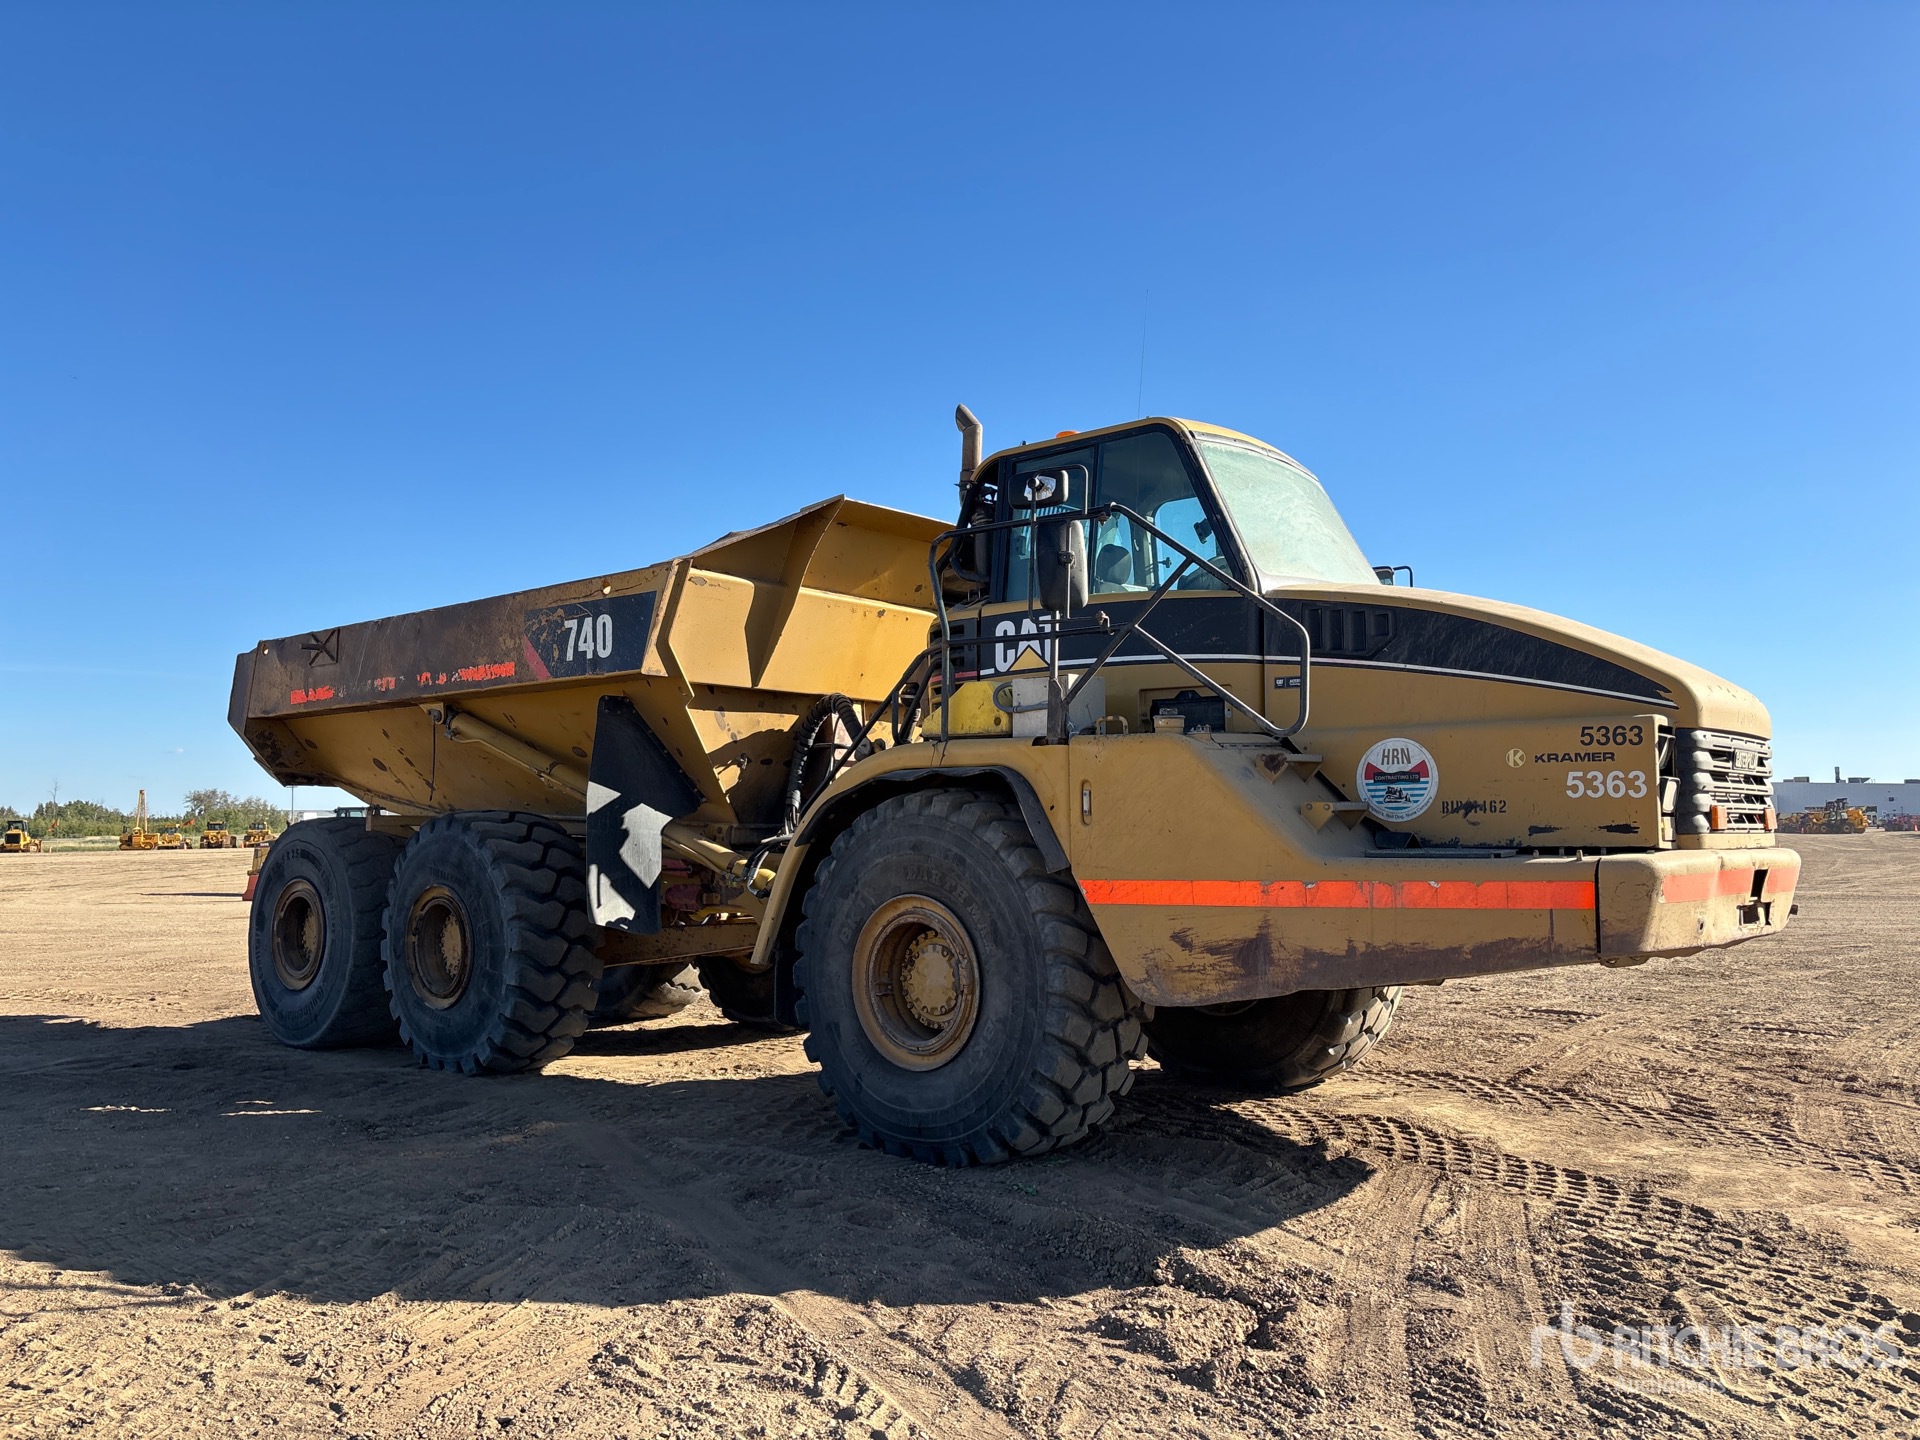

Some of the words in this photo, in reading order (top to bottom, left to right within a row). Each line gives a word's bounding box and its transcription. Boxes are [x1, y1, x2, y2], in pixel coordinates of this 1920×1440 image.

[564, 614, 613, 662] 740
[995, 615, 1052, 673] CAT
[1580, 725, 1644, 746] 5363
[1381, 748, 1411, 765] HRN
[1534, 752, 1616, 763] KRAMER
[1565, 770, 1648, 799] 5363
